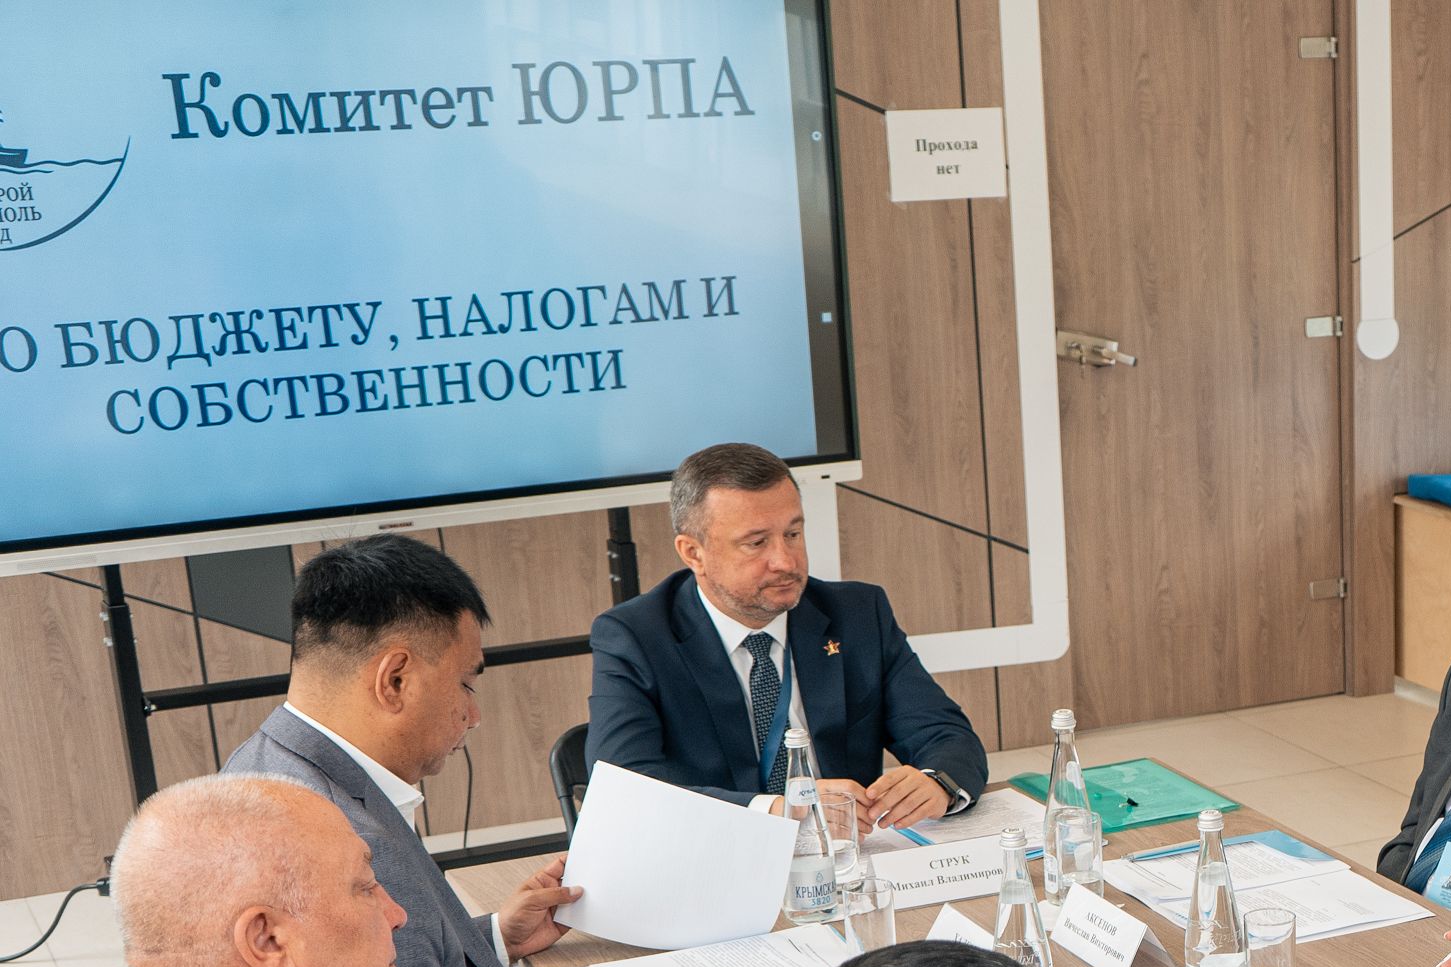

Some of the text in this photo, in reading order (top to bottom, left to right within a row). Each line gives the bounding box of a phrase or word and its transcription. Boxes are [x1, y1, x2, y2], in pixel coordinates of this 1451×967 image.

[163, 56, 756, 140] Комитет ЮРПА
[915, 138, 979, 155] Прохода
[936, 163, 960, 175] нет
[54, 300, 401, 371] БЮДЖЕТУ,
[412, 279, 687, 341] НАЛОГАМ
[700, 276, 739, 317] И
[106, 349, 628, 435] СОБСТВЕННОСТИ
[930, 854, 971, 870] СТРУК
[890, 875, 934, 892] Михаил
[1086, 912, 1119, 937] АКСЕНОВ
[1063, 917, 1125, 962] Вячеслав Викторович
